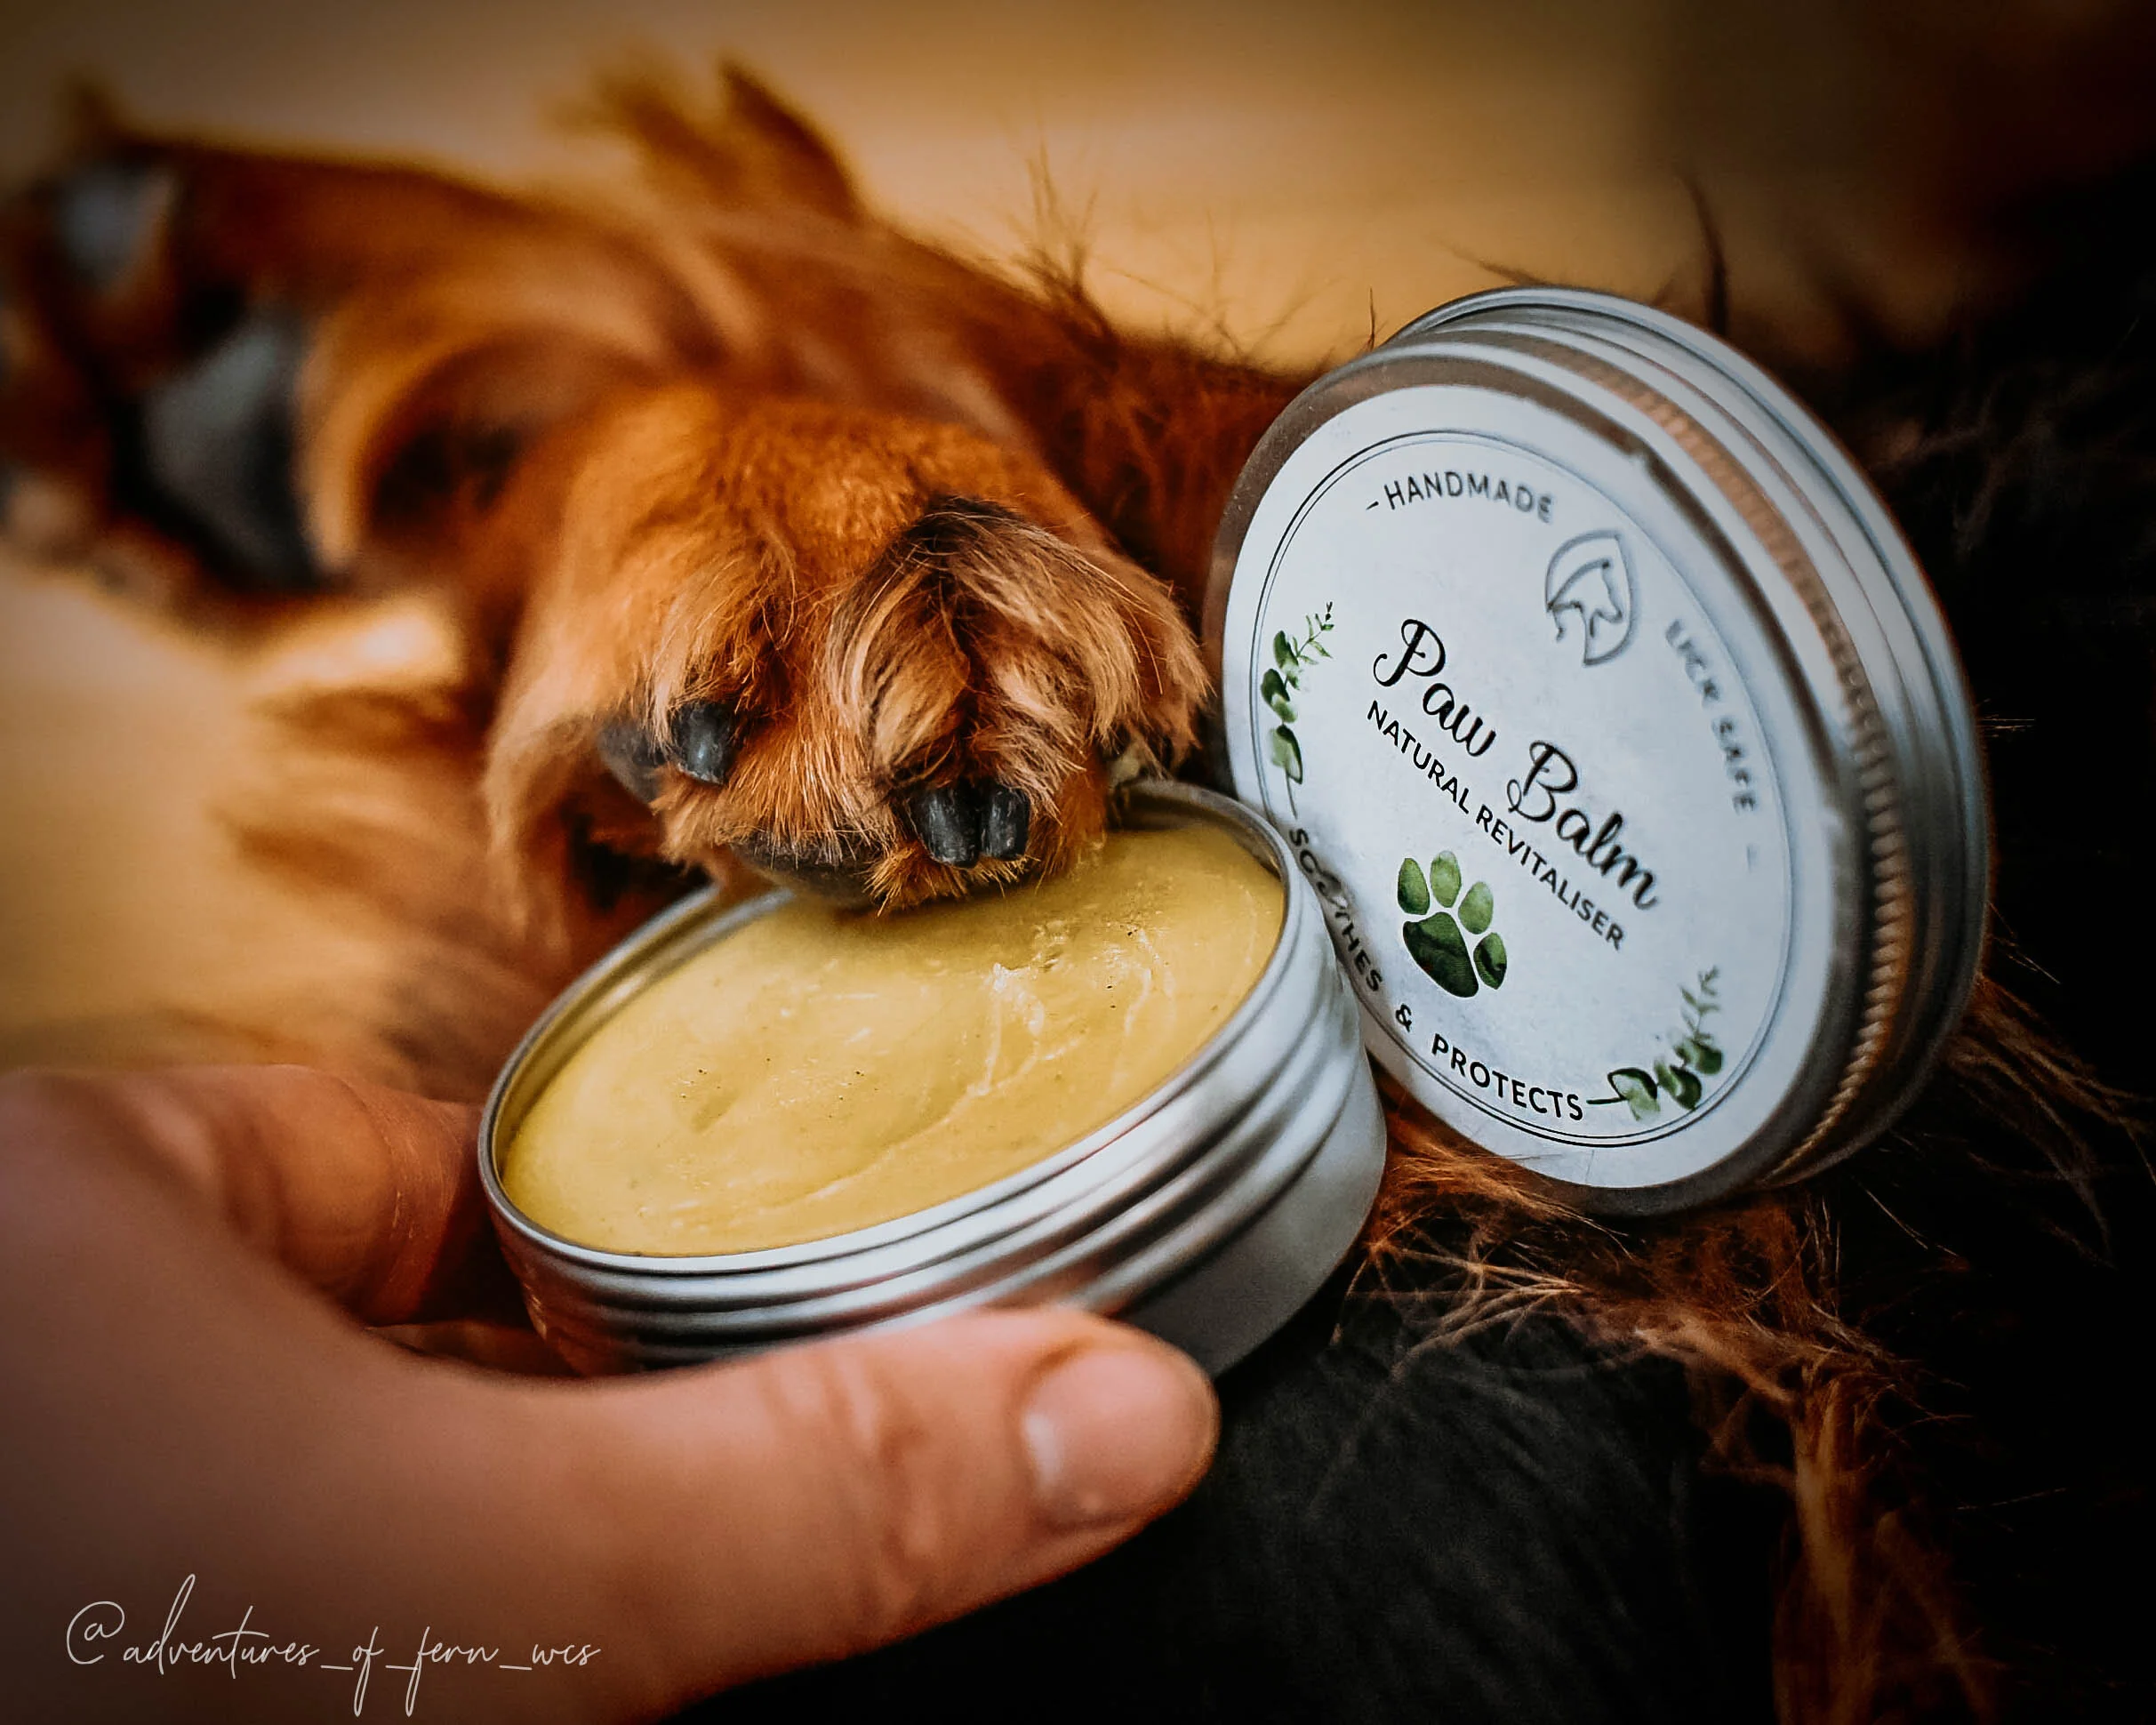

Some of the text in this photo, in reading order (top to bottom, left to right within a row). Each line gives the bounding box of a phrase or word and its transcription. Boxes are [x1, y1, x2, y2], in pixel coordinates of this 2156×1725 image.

[1383, 470, 1553, 523] HANDMADE
[1366, 699, 1625, 951] NATURAL REVITALISER
[1373, 618, 1661, 911] Paw Balm
[1394, 1002, 1414, 1033] &
[1431, 1033, 1584, 1122] PROTECTS
